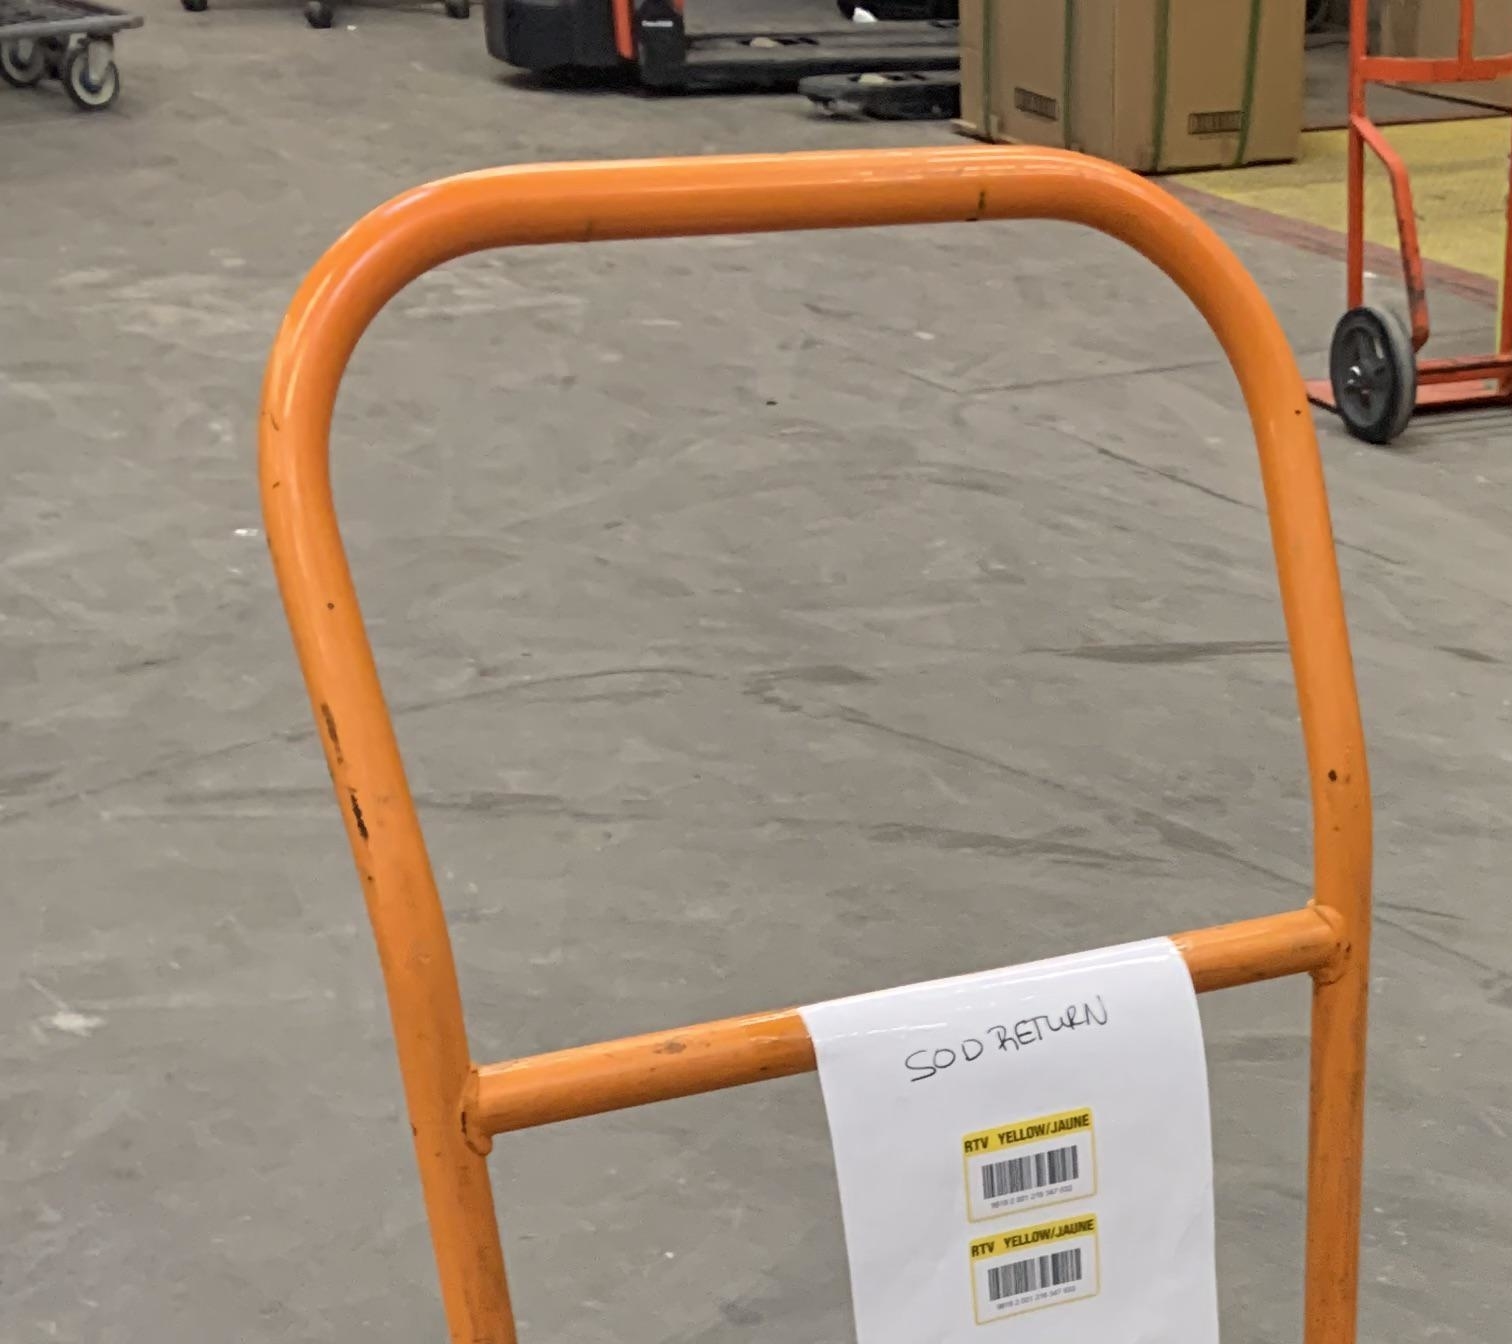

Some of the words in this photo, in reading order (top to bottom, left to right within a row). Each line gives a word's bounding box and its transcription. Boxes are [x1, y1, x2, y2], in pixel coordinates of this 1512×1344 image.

[904, 1038, 985, 1083] SOD
[986, 994, 1109, 1052] RETURN
[963, 1135, 990, 1154] RTV
[997, 1113, 1090, 1146] YELLOW/JAUNE
[970, 1240, 996, 1258] RTV
[1002, 1218, 1095, 1249] YELLOW/JAUNE
